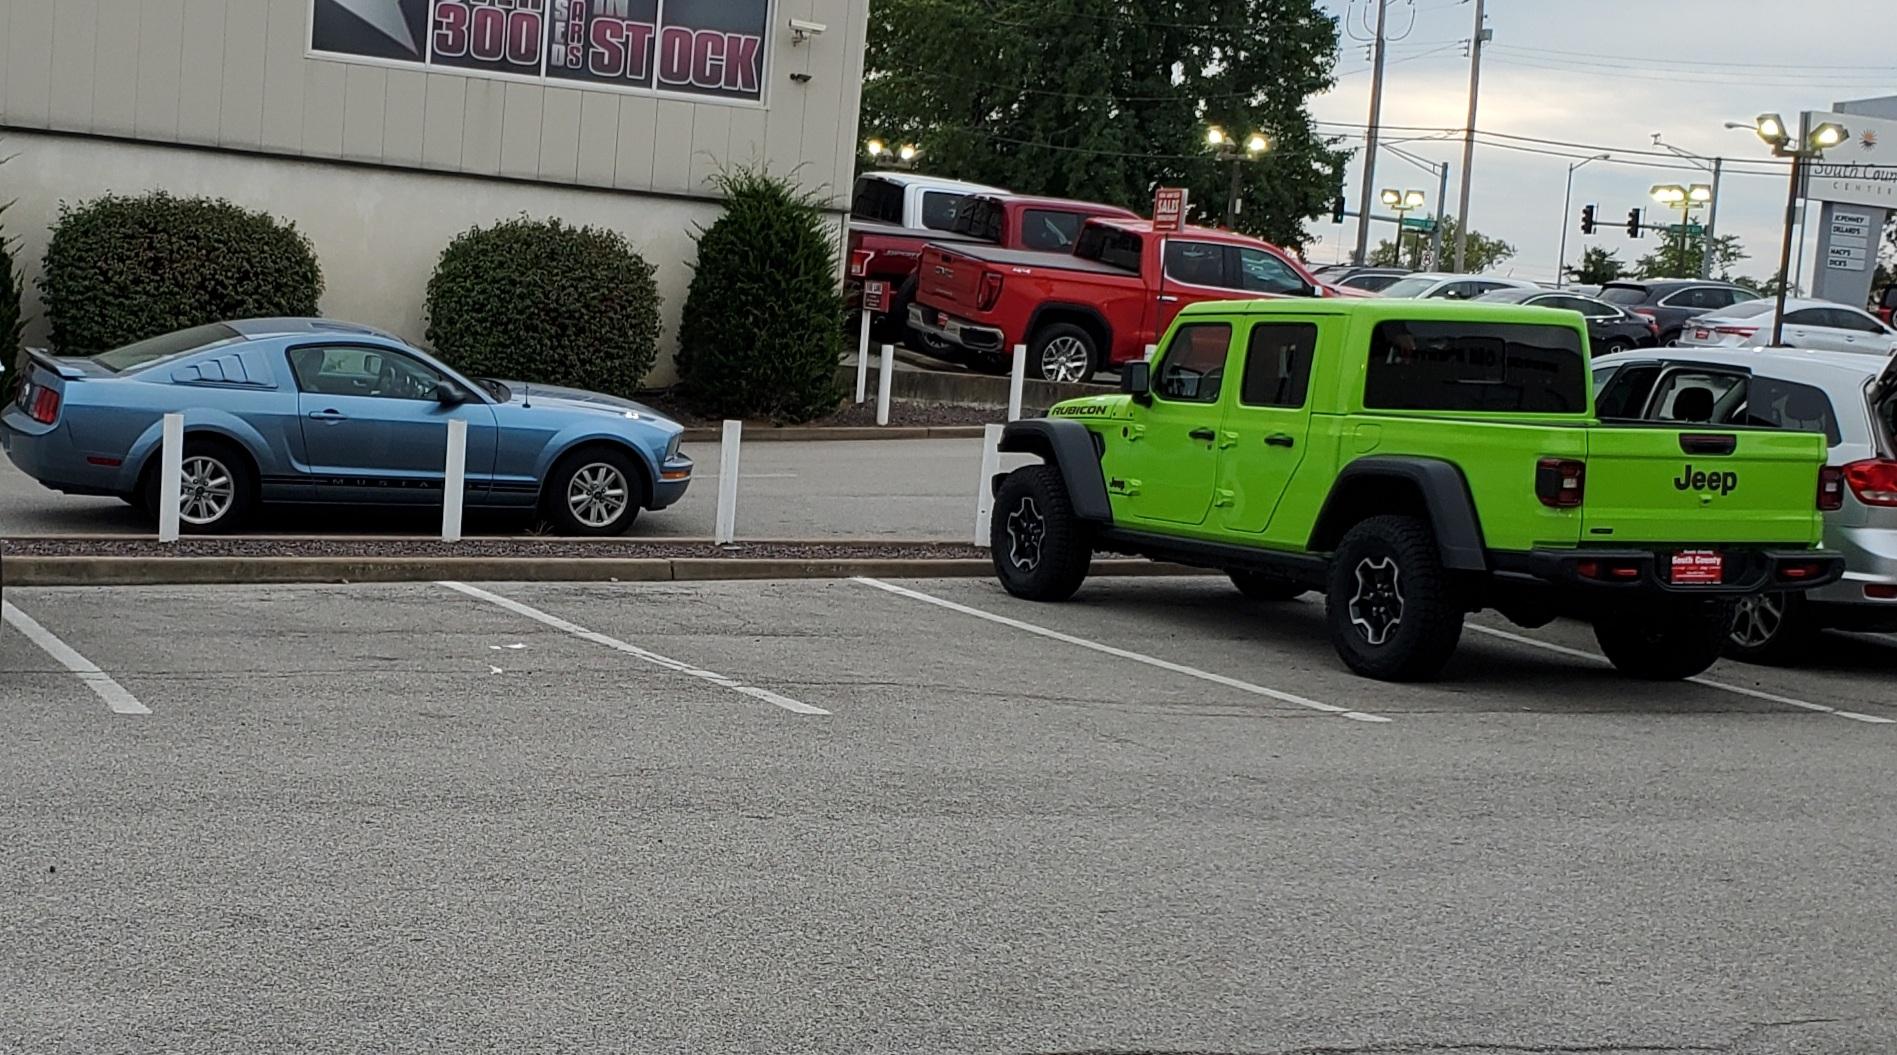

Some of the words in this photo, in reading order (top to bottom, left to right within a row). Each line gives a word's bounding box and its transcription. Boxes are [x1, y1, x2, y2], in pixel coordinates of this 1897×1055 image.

[433, 2, 541, 65] 300
[588, 17, 760, 92] STOCK
[1833, 181, 1891, 195] CENTER
[1051, 405, 1107, 415] RUBICON
[1674, 464, 1737, 496] Jeep
